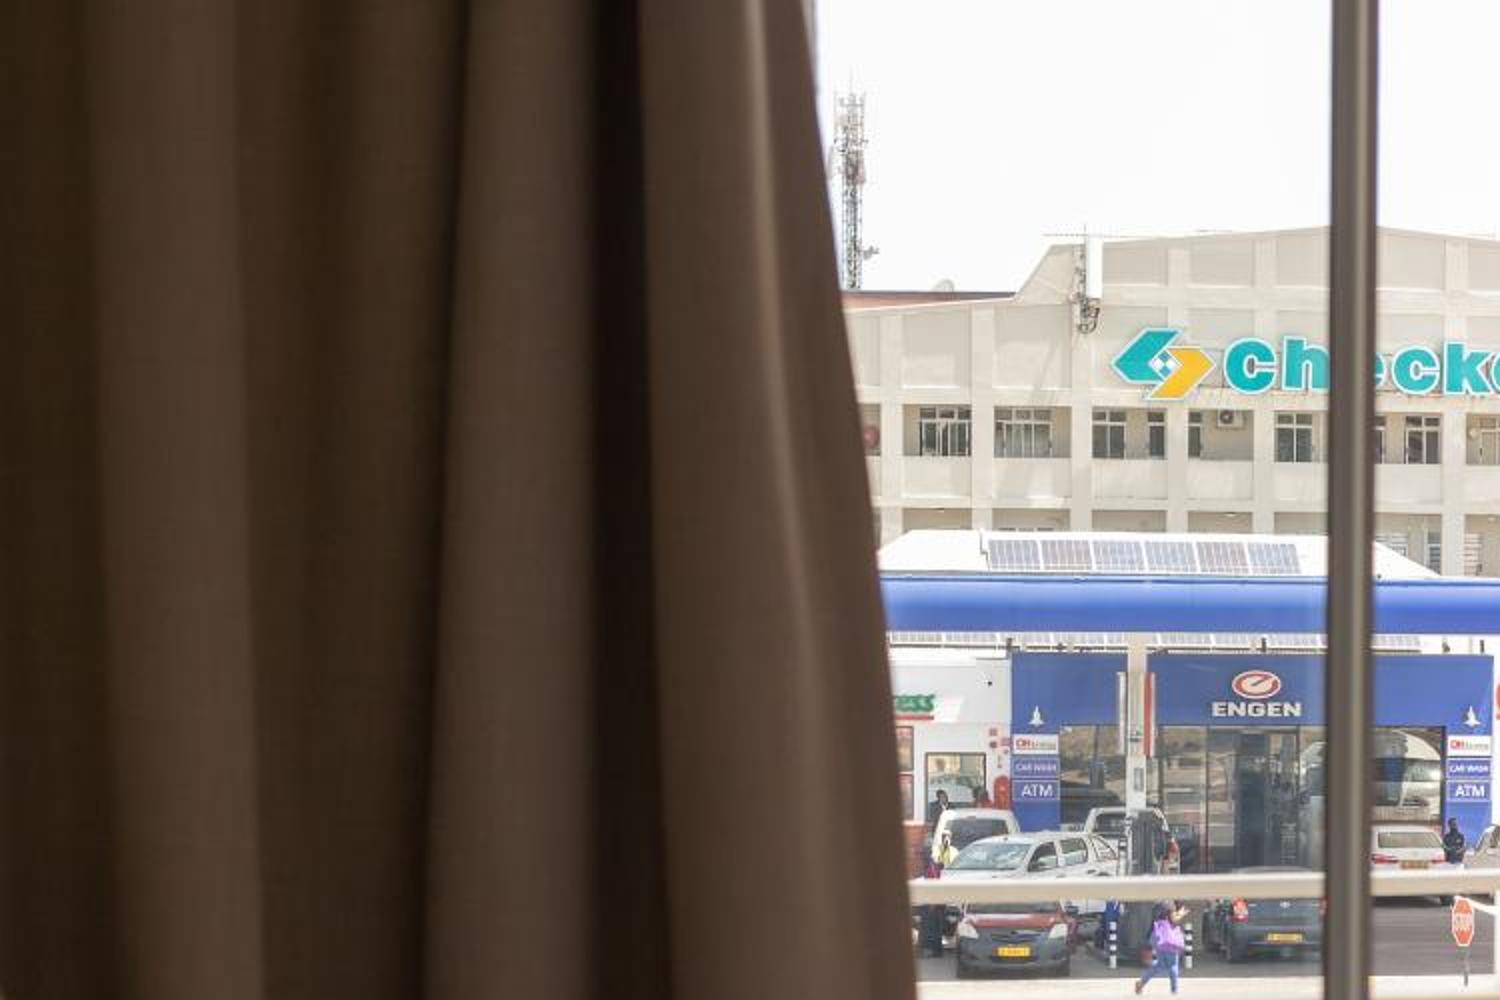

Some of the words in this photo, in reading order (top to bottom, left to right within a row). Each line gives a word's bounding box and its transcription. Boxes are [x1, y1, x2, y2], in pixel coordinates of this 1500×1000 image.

[1212, 702, 1301, 717] ENGEN
[1022, 784, 1053, 797] ATM
[1456, 784, 1485, 797] ATM
